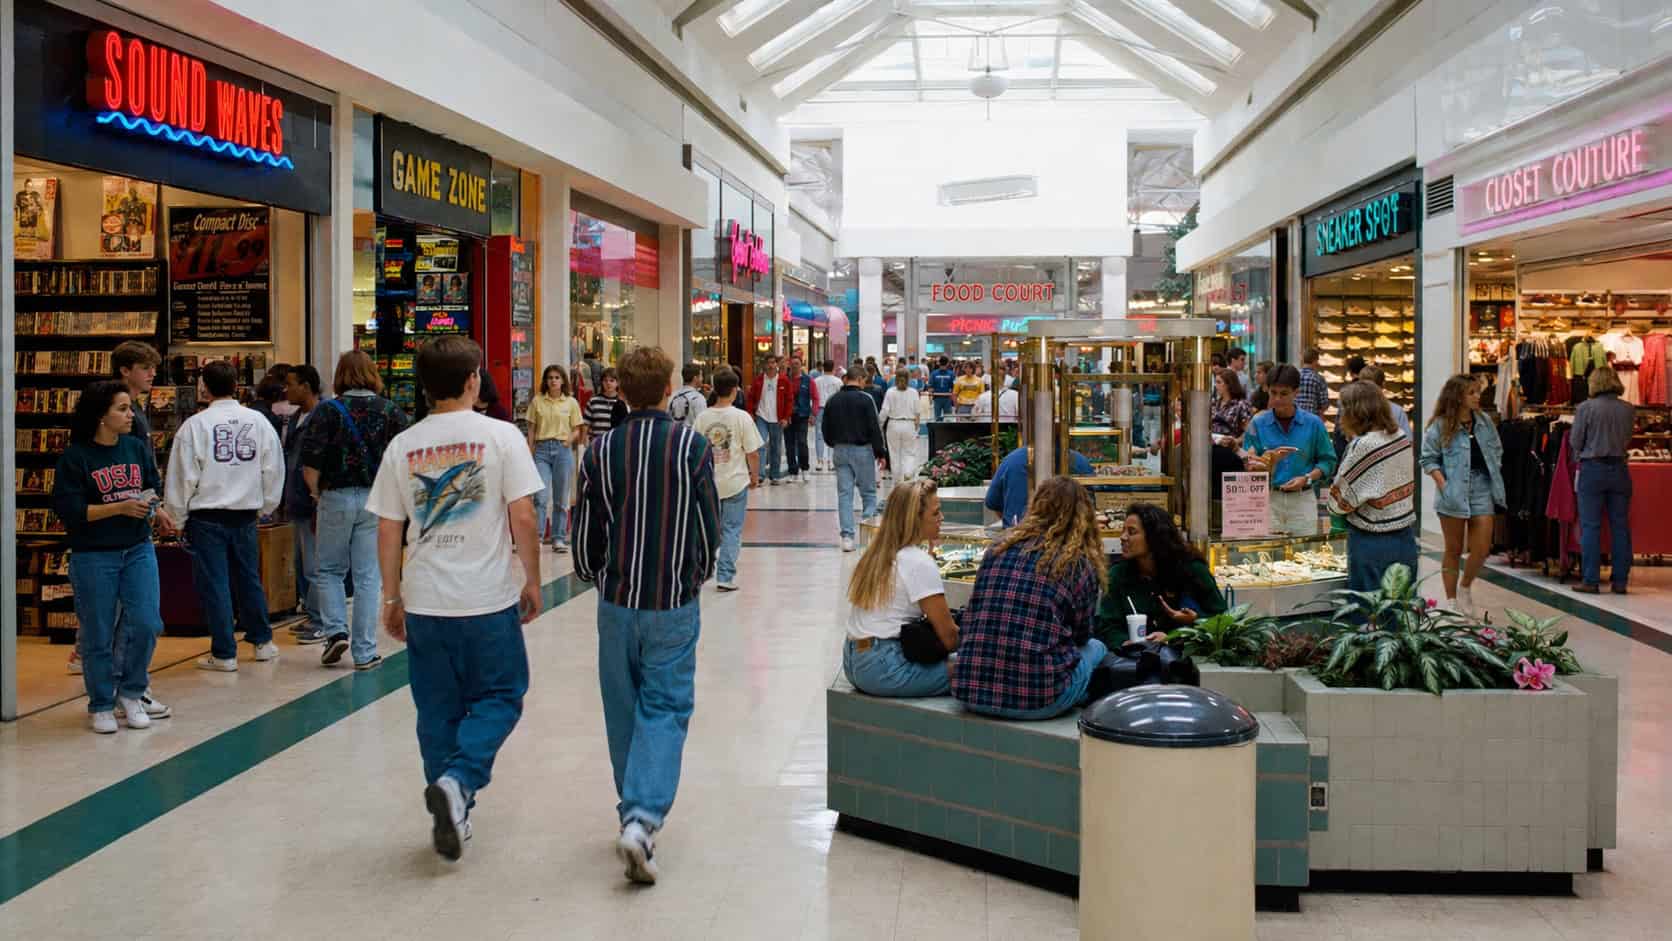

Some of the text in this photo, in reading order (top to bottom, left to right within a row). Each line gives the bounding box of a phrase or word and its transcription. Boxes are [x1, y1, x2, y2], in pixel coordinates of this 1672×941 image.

[104, 31, 283, 154] SOUND WAVES
[392, 149, 487, 213] GAME ZONE
[1485, 129, 1643, 211] CLOSET COUTURE
[193, 213, 237, 234] Compact
[237, 212, 260, 231] Disc
[1365, 191, 1400, 242] SPOT
[932, 282, 1055, 303] FOOD COURT
[213, 424, 256, 462] 86
[91, 464, 142, 493] USA
[1250, 485, 1265, 494] OFF
